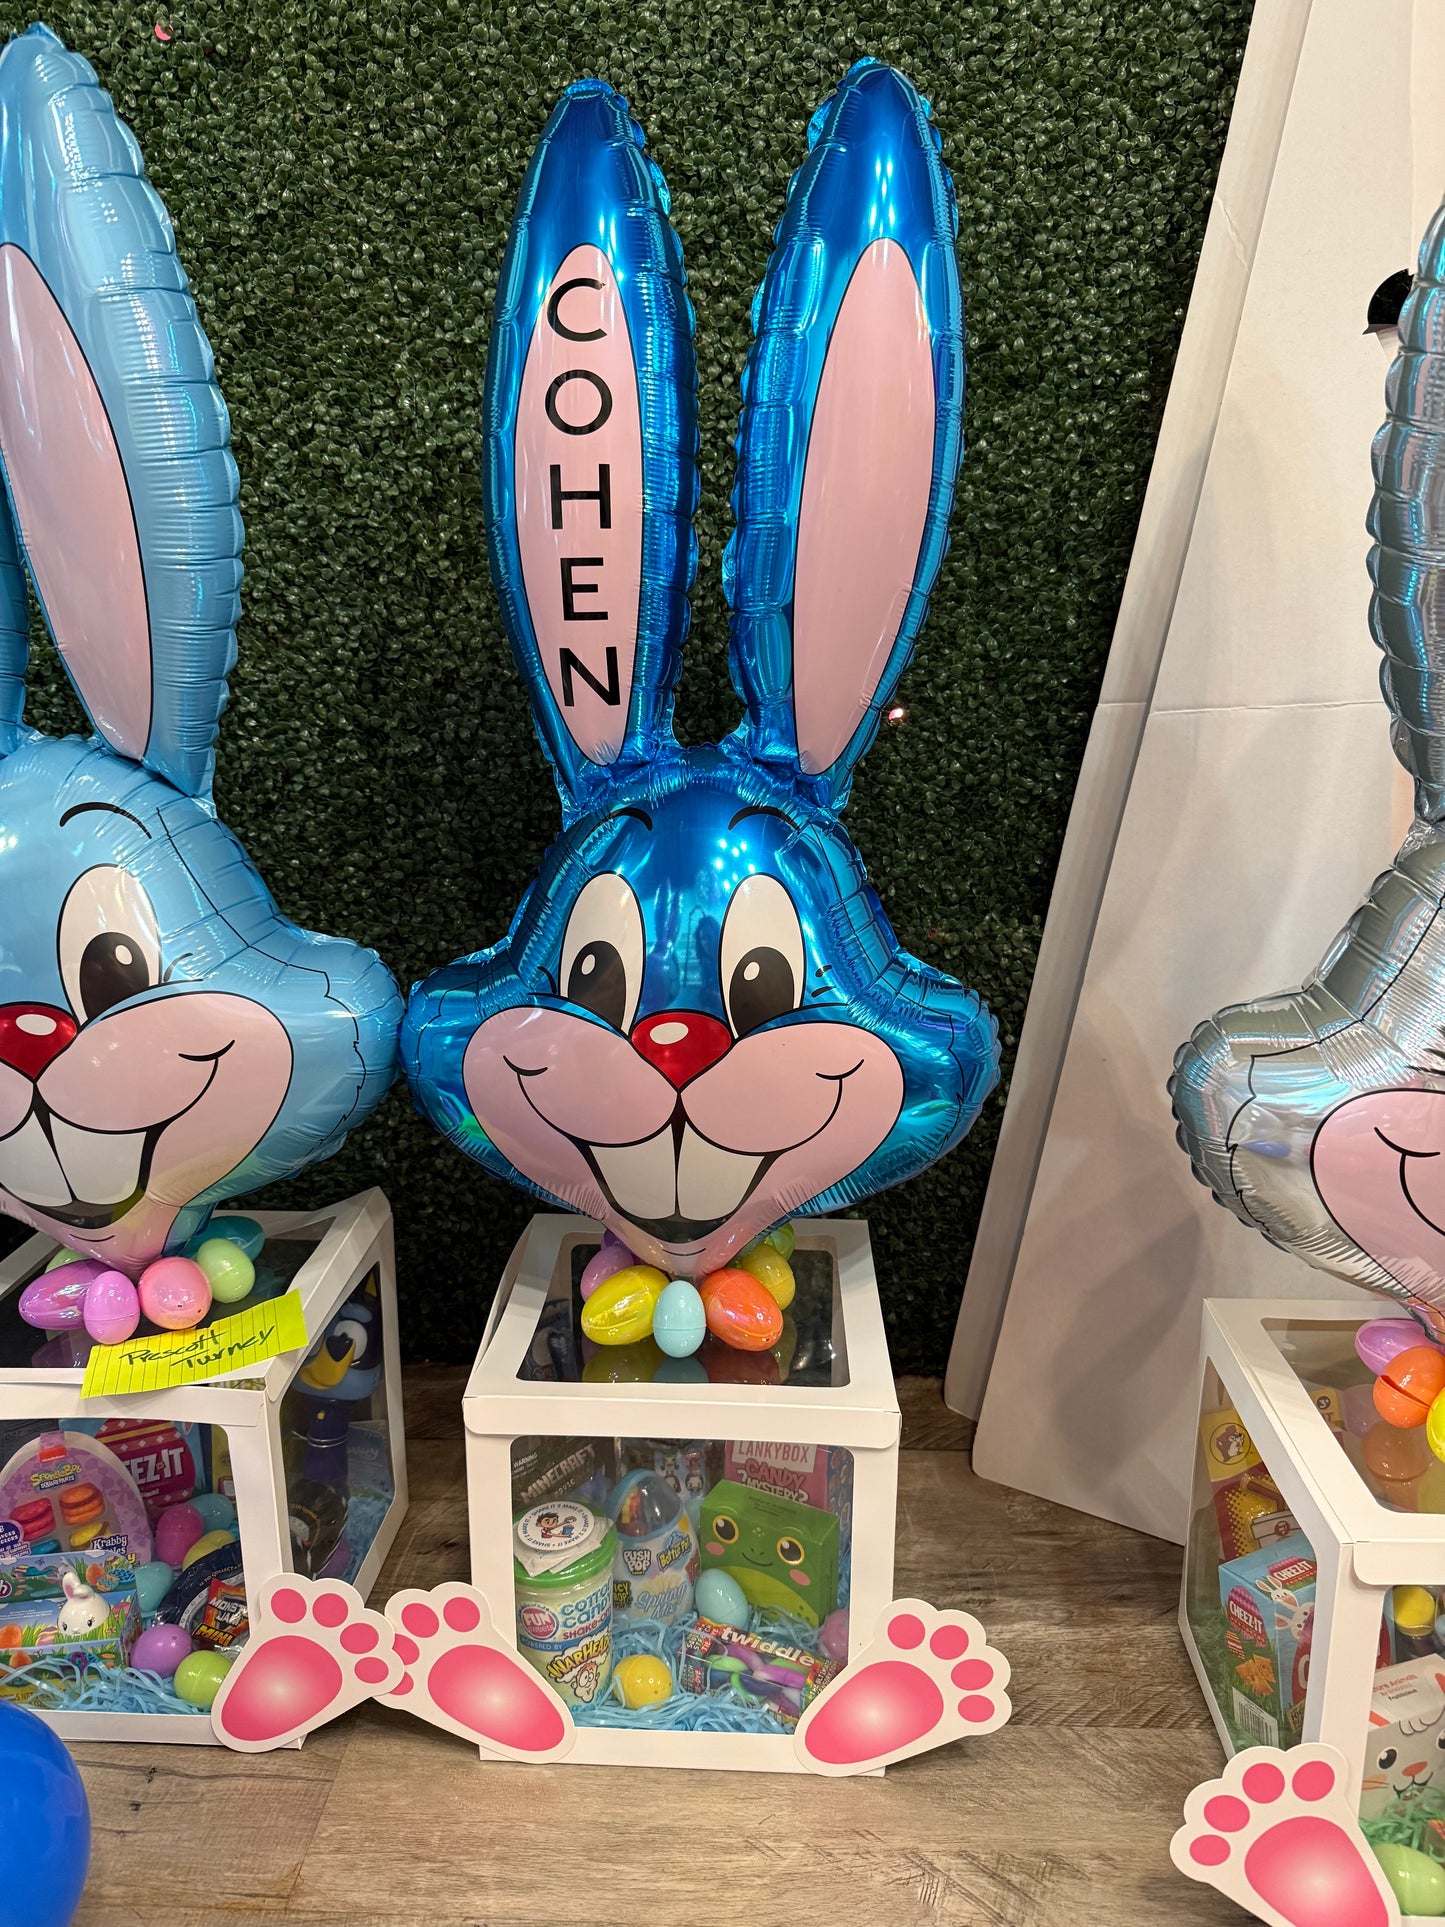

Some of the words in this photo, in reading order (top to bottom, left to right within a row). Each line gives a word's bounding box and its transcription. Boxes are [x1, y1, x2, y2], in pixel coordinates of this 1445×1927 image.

[544, 277, 622, 707] COHEN
[119, 1329, 231, 1366] Prescott
[170, 1325, 275, 1369] Turney
[738, 1440, 810, 1464] LANKYBOX
[520, 1443, 595, 1504] MINECRAFT
[744, 1457, 807, 1492] CANDY
[93, 1535, 128, 1550] Krabby
[623, 1550, 651, 1561] PUSH
[628, 1559, 650, 1572] POP
[1273, 1560, 1314, 1581] CHEEZ-IT
[614, 1582, 629, 1595] ICY
[635, 1582, 687, 1613] Spring
[523, 1612, 552, 1626] FUN
[1229, 1600, 1263, 1635] CHEEZ-IT
[193, 1624, 235, 1647] MINI
[720, 1626, 815, 1667] twiddle
